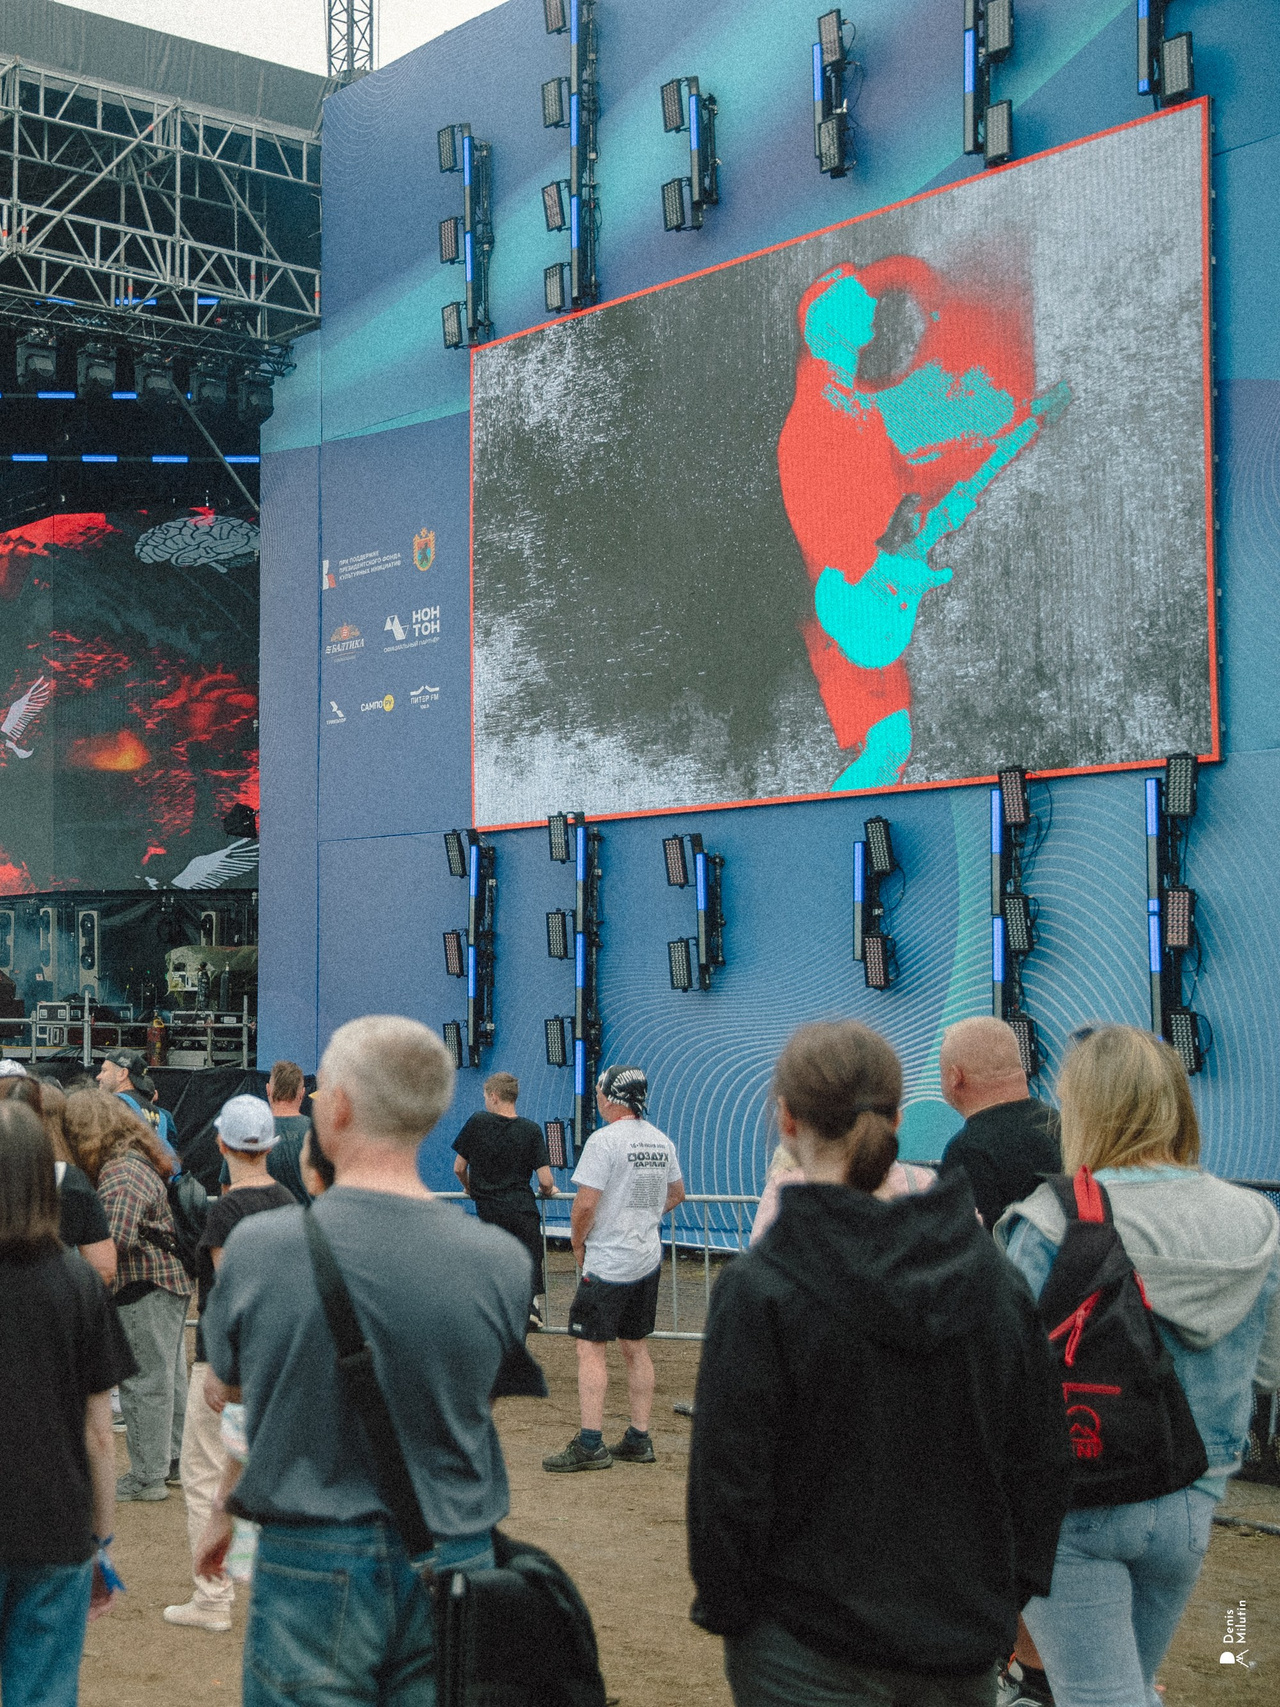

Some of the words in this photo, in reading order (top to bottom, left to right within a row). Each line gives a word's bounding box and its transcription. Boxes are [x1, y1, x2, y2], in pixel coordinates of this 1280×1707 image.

[412, 605, 440, 624] НОН
[412, 620, 440, 637] ТОН
[331, 638, 365, 654] БАЛТИКА
[410, 695, 430, 705] ПИТЕР
